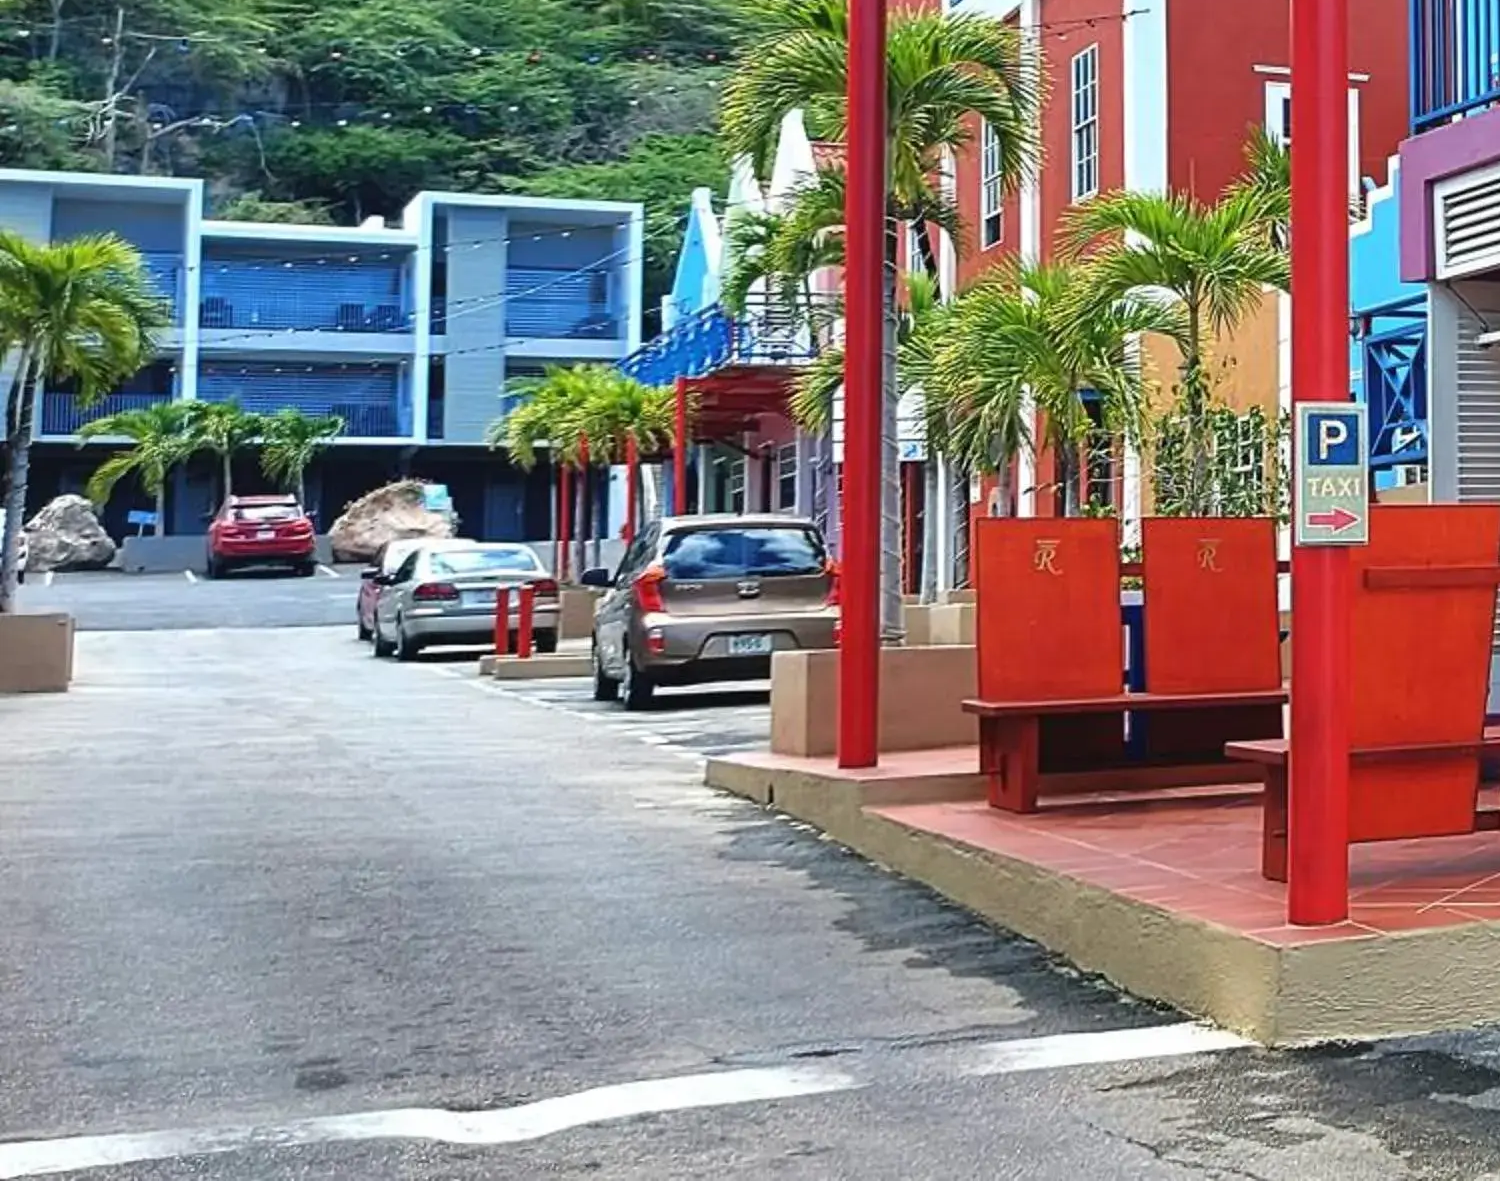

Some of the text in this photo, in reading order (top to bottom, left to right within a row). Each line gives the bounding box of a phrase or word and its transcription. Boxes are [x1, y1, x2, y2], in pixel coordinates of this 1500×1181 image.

[1320, 420, 1348, 460] P
[1306, 477, 1361, 498] TAXI
[1034, 547, 1063, 575] R
